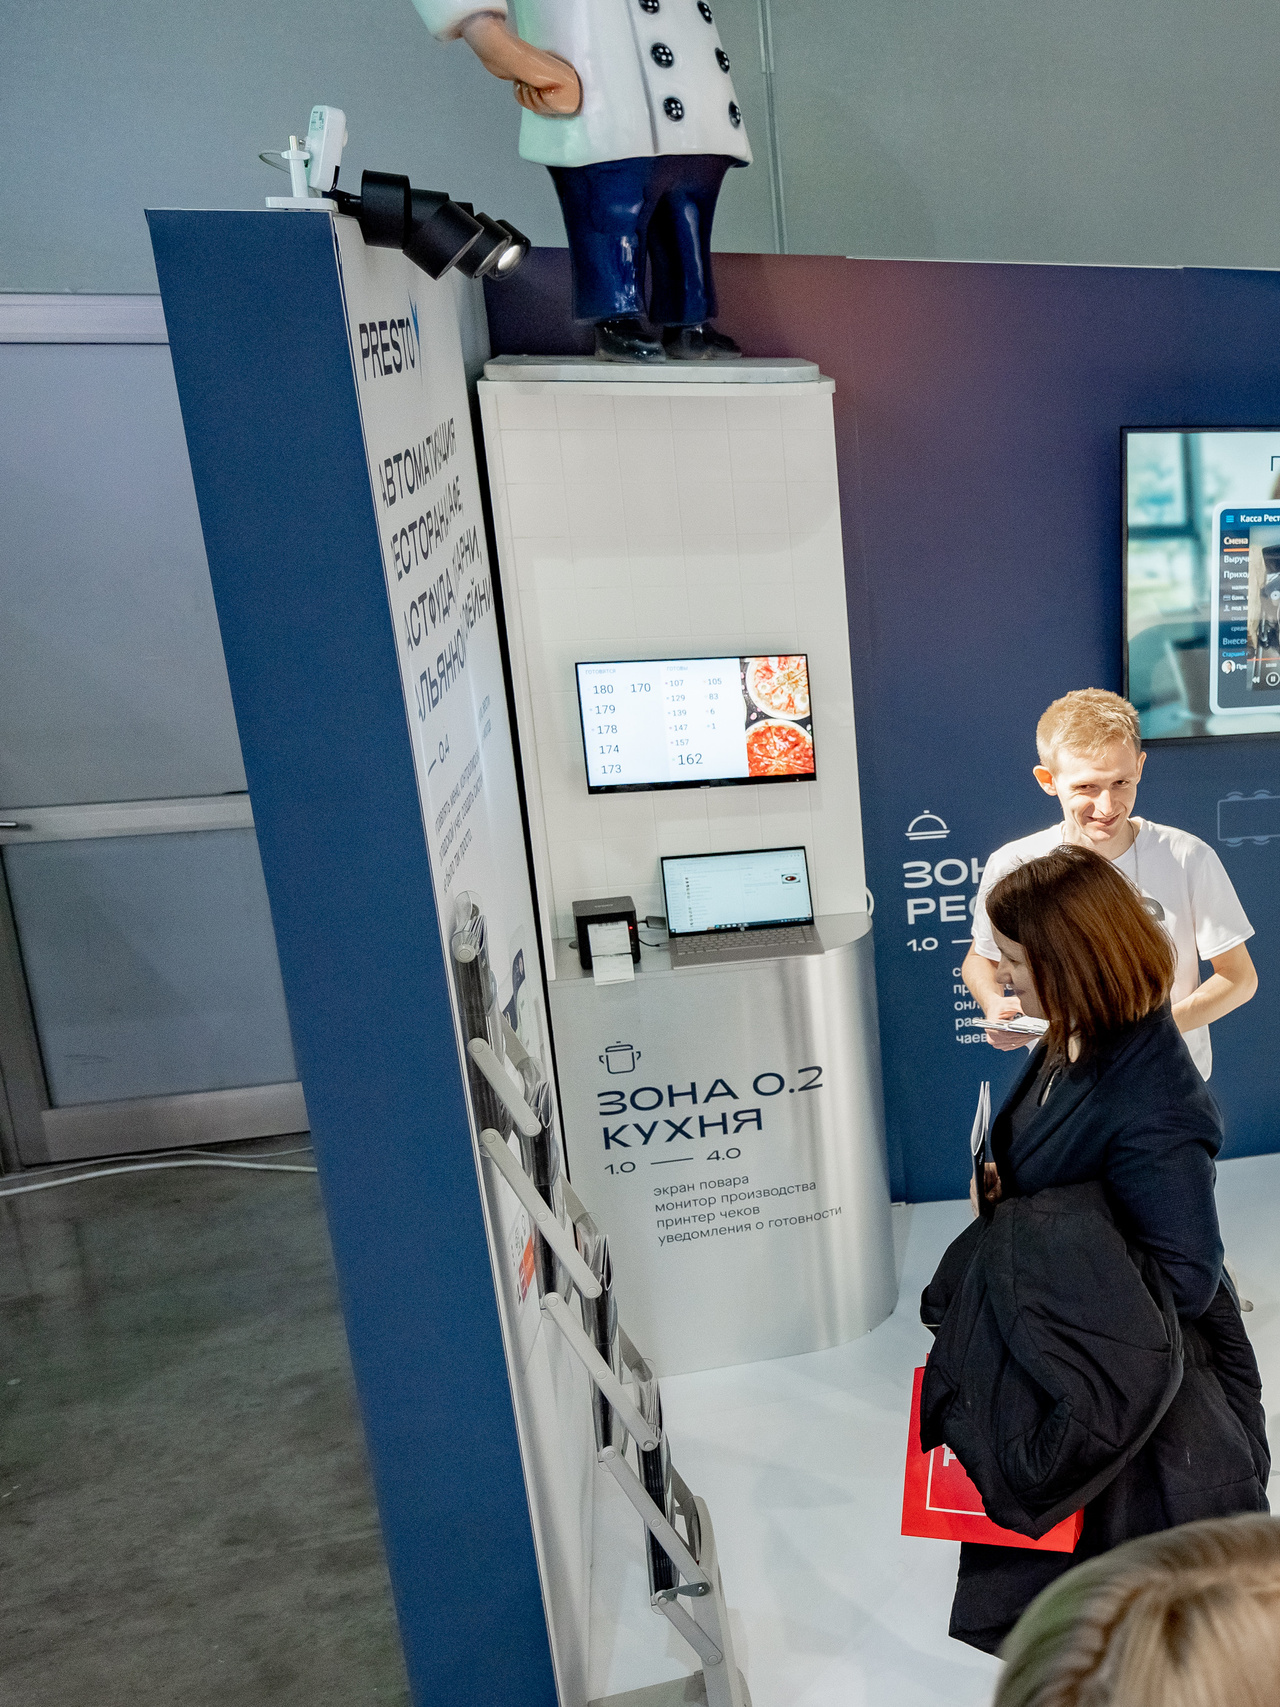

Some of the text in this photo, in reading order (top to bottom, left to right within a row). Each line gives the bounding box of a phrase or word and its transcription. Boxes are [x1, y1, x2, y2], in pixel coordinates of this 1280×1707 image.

[359, 317, 415, 381] PRESTO
[1240, 514, 1262, 524] Касса
[593, 682, 651, 695] 180 170
[670, 677, 722, 687] 107 105
[671, 692, 719, 702] 129 83
[595, 704, 616, 715] 179
[672, 707, 716, 717] 139 6
[597, 724, 618, 735] 178
[675, 738, 689, 746] 157
[599, 744, 620, 755] 174
[678, 752, 703, 766] 162
[601, 764, 622, 775] 173
[903, 857, 986, 889] ЗОН
[906, 894, 976, 925] РЕ
[906, 937, 939, 952] 1.0
[597, 1065, 824, 1116] ЗОНА 0.2
[602, 1107, 763, 1150] КУХНЯ
[604, 1147, 742, 1175] 1.0 4.0
[653, 1174, 750, 1198] экран повара
[654, 1180, 817, 1213] монитор производства
[656, 1205, 761, 1229] принтер чеков
[657, 1205, 843, 1247] уведомления о готовности
